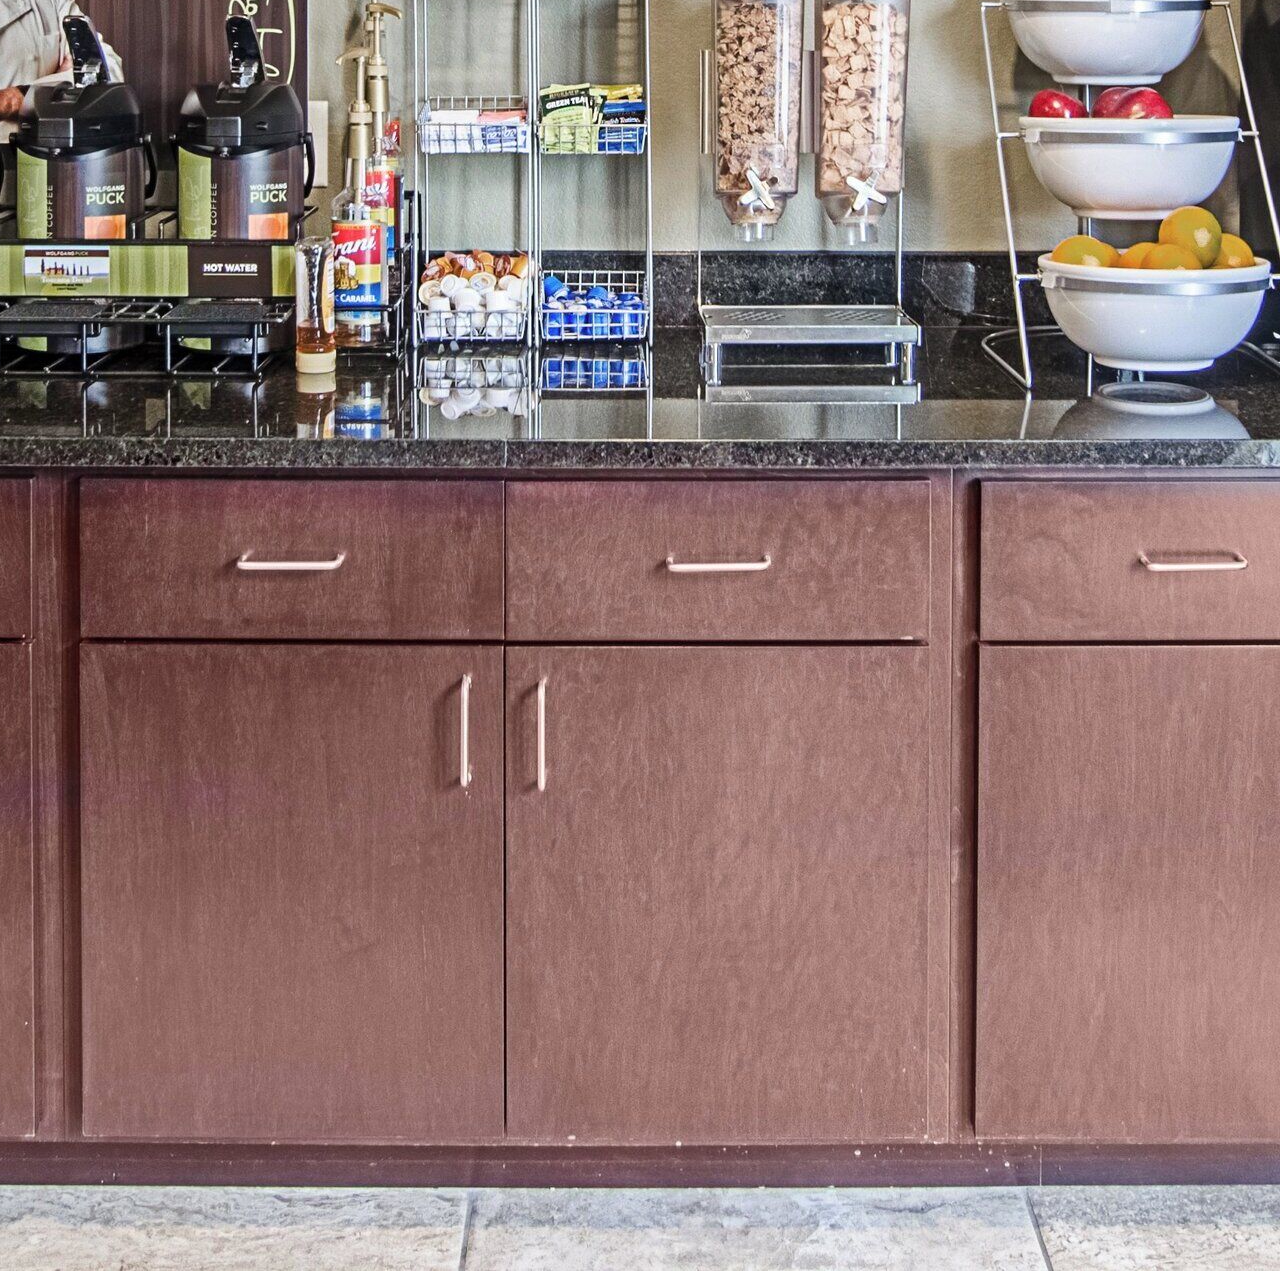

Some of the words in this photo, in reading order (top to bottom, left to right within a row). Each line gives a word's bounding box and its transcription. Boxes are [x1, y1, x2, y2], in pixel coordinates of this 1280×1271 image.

[546, 98, 571, 110] GREEN
[85, 184, 126, 193] WOLFGANG
[249, 182, 288, 191] WOLFGANG
[86, 192, 125, 205] PUCK
[250, 190, 288, 203] PUCK
[332, 229, 377, 256] rani
[203, 263, 223, 273] HOT
[224, 263, 258, 273] WATER
[339, 293, 378, 303] CARAMEL
